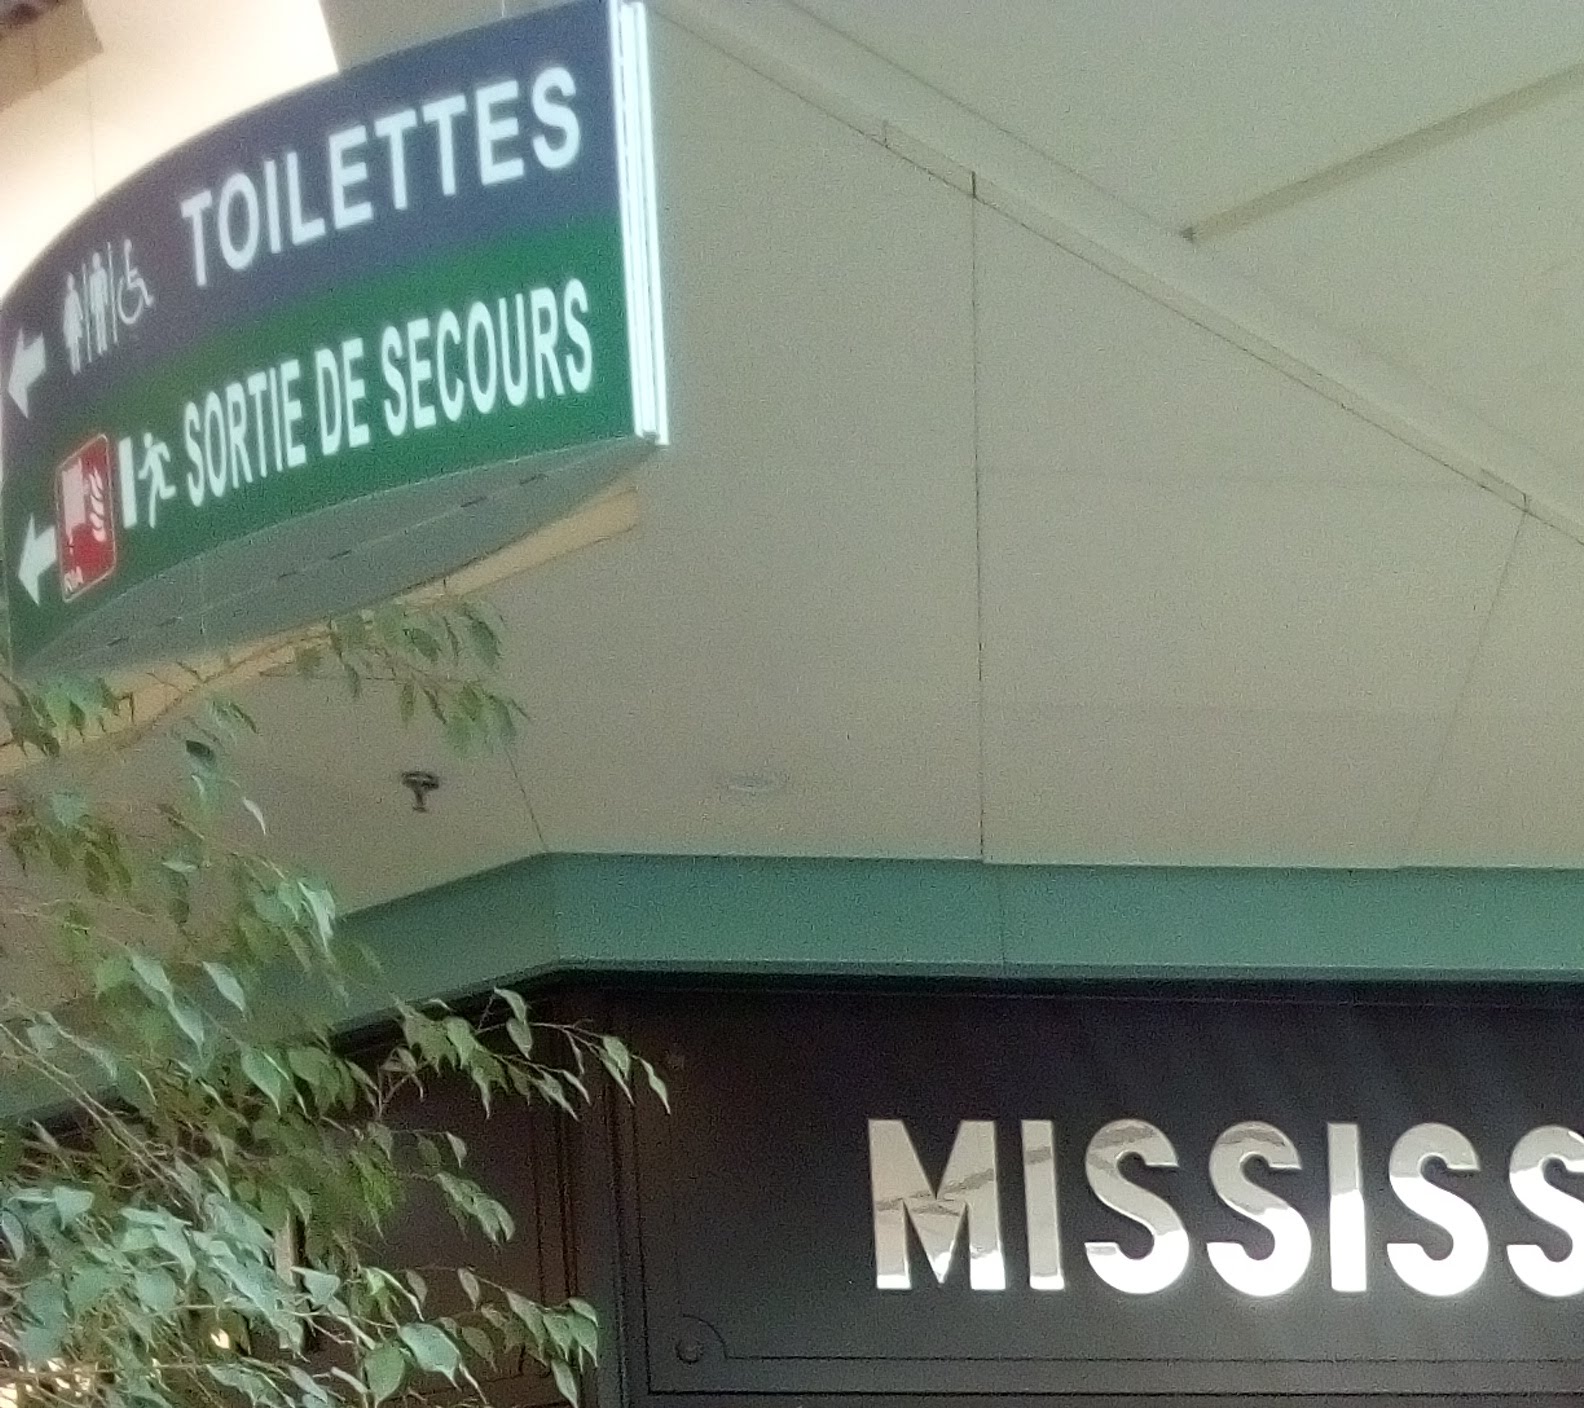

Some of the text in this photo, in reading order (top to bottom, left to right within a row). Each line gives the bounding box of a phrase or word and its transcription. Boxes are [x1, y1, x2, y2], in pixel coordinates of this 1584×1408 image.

[180, 66, 583, 288] TOILETTES
[182, 277, 594, 508] SORTIE DE SECOURS
